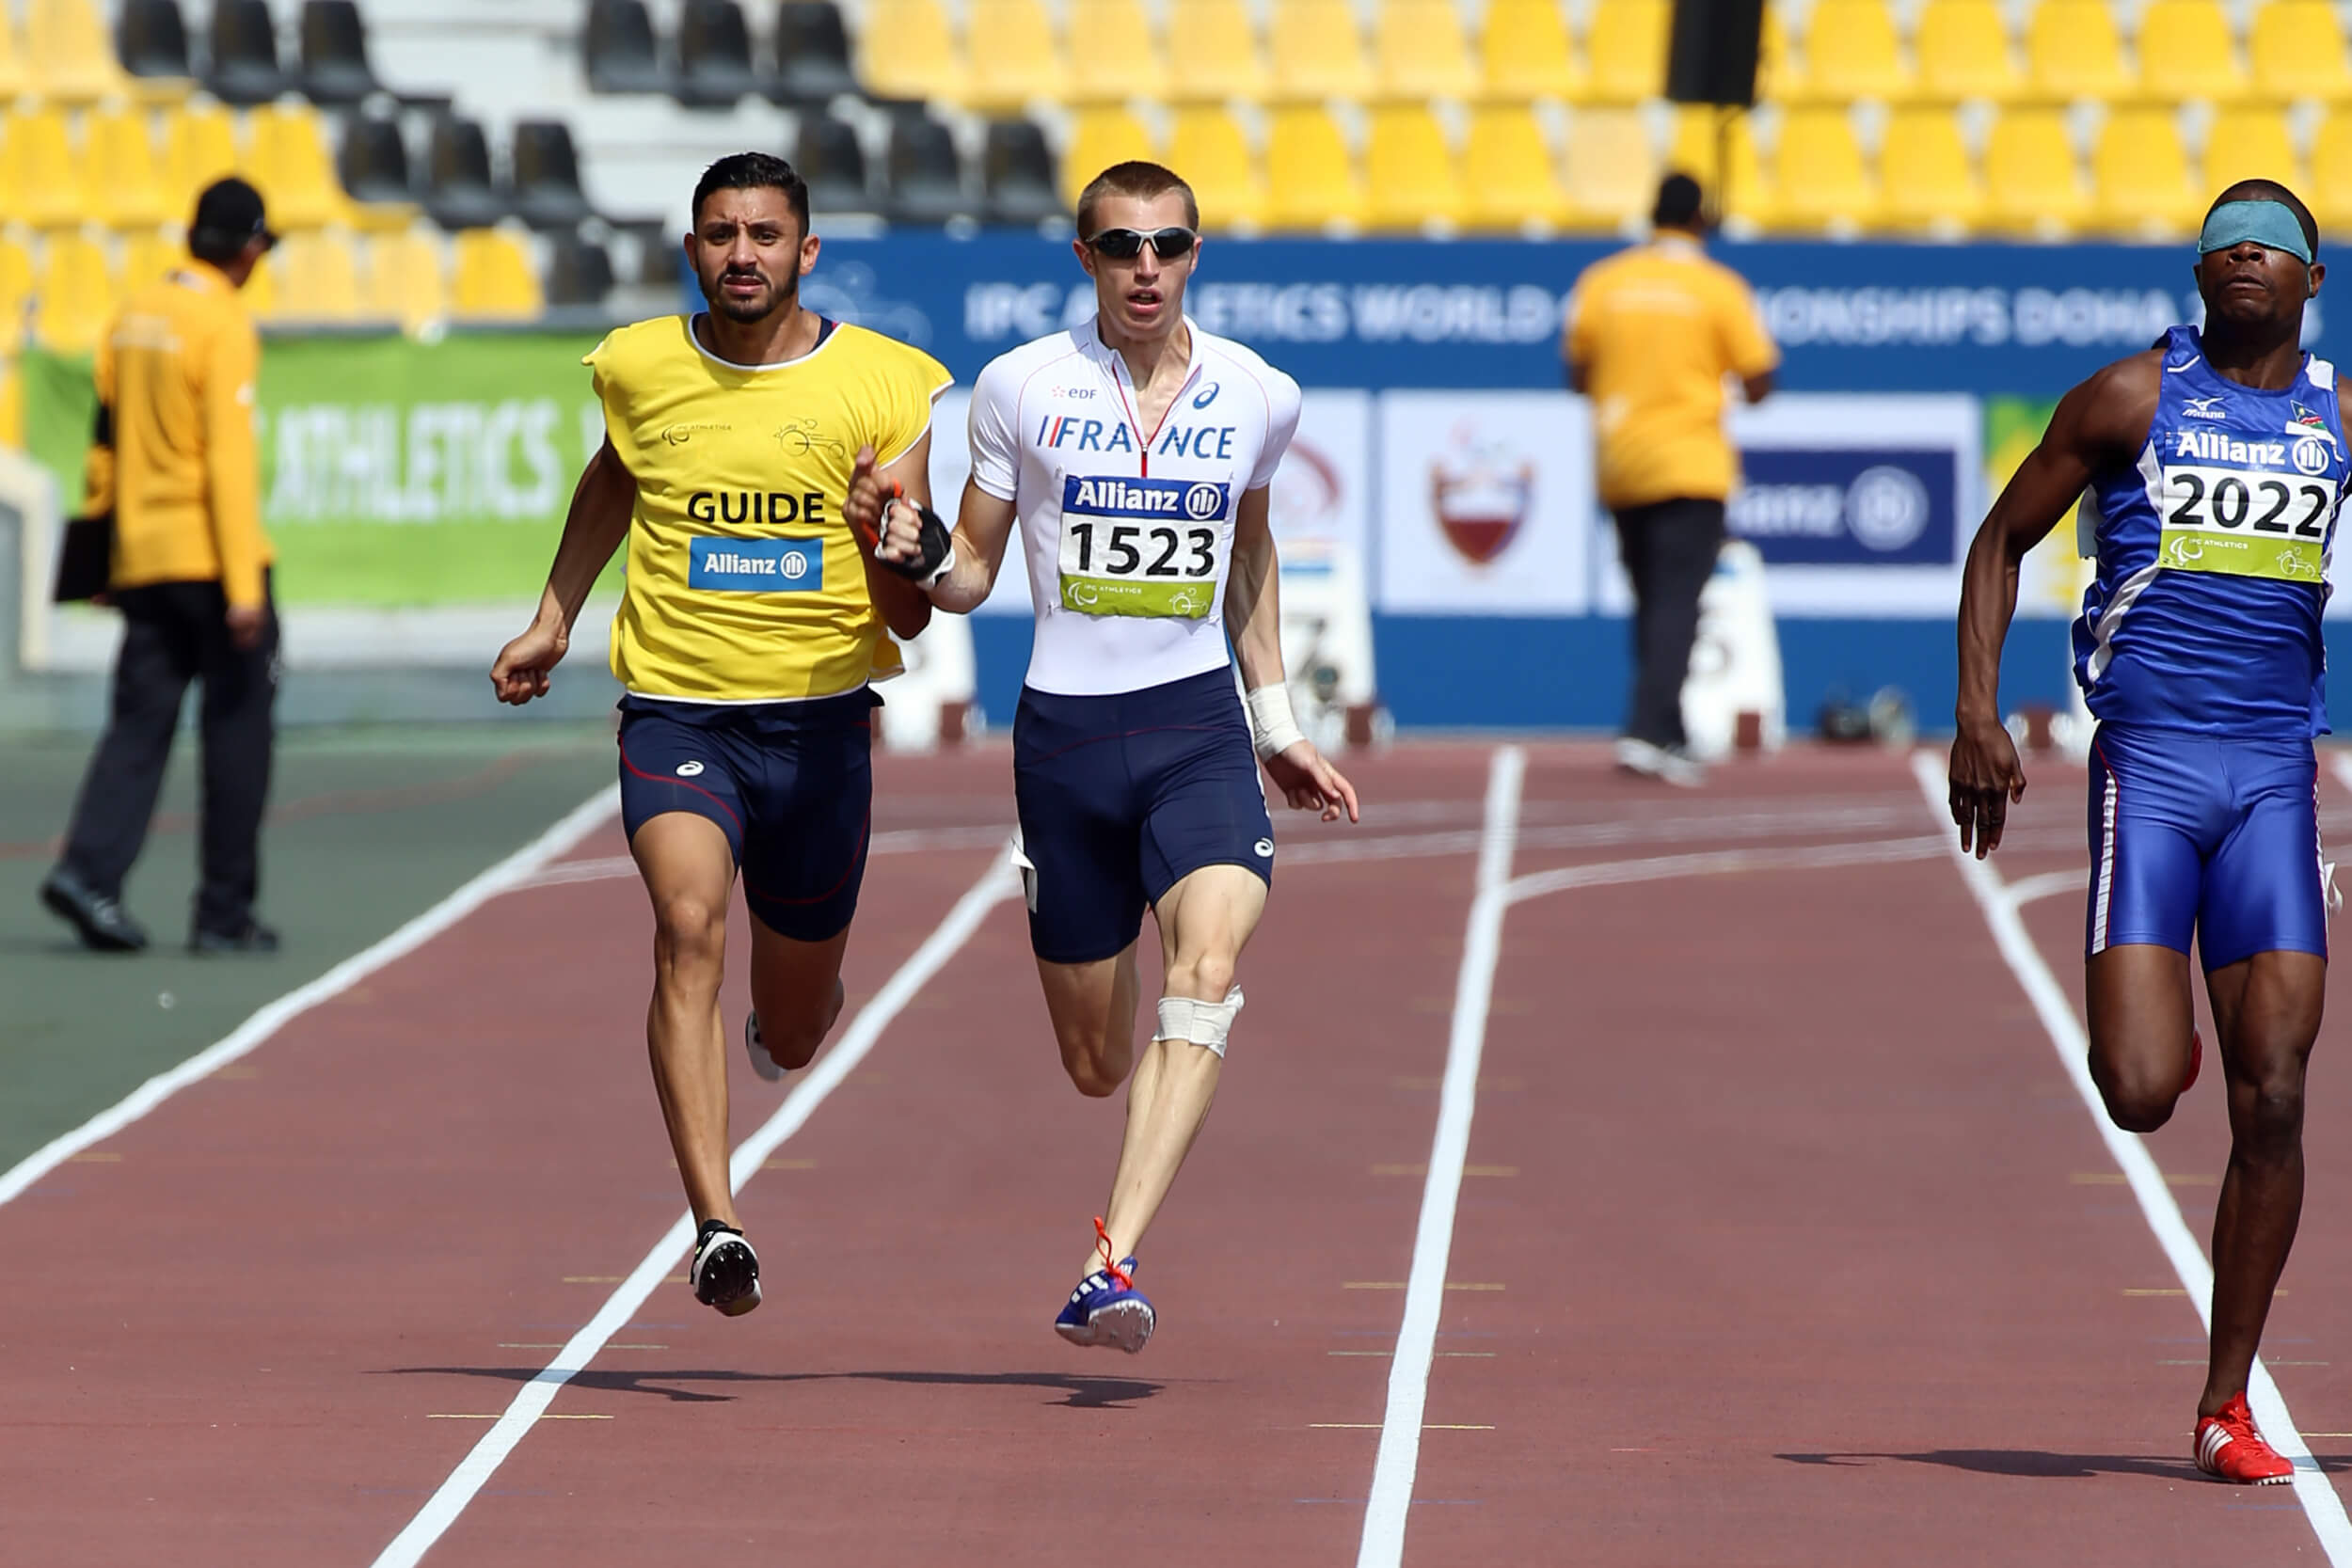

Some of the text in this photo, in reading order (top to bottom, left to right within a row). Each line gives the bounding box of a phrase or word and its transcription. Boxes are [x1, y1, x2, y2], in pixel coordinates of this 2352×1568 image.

[965, 283, 1059, 341] IPC
[1353, 283, 1554, 343] WORLD
[2015, 287, 2181, 347] DOHA
[268, 399, 563, 523] ATHLETICS
[2176, 432, 2285, 466] Allianz
[688, 491, 825, 524] GUIDE
[1074, 481, 1179, 511] Allianz
[2169, 473, 2328, 538] 2022
[1071, 523, 1215, 578] 1523
[2204, 539, 2249, 549] ATHLETICS
[704, 552, 776, 575] Allianz
[1099, 586, 1142, 594] ATHLETICS
